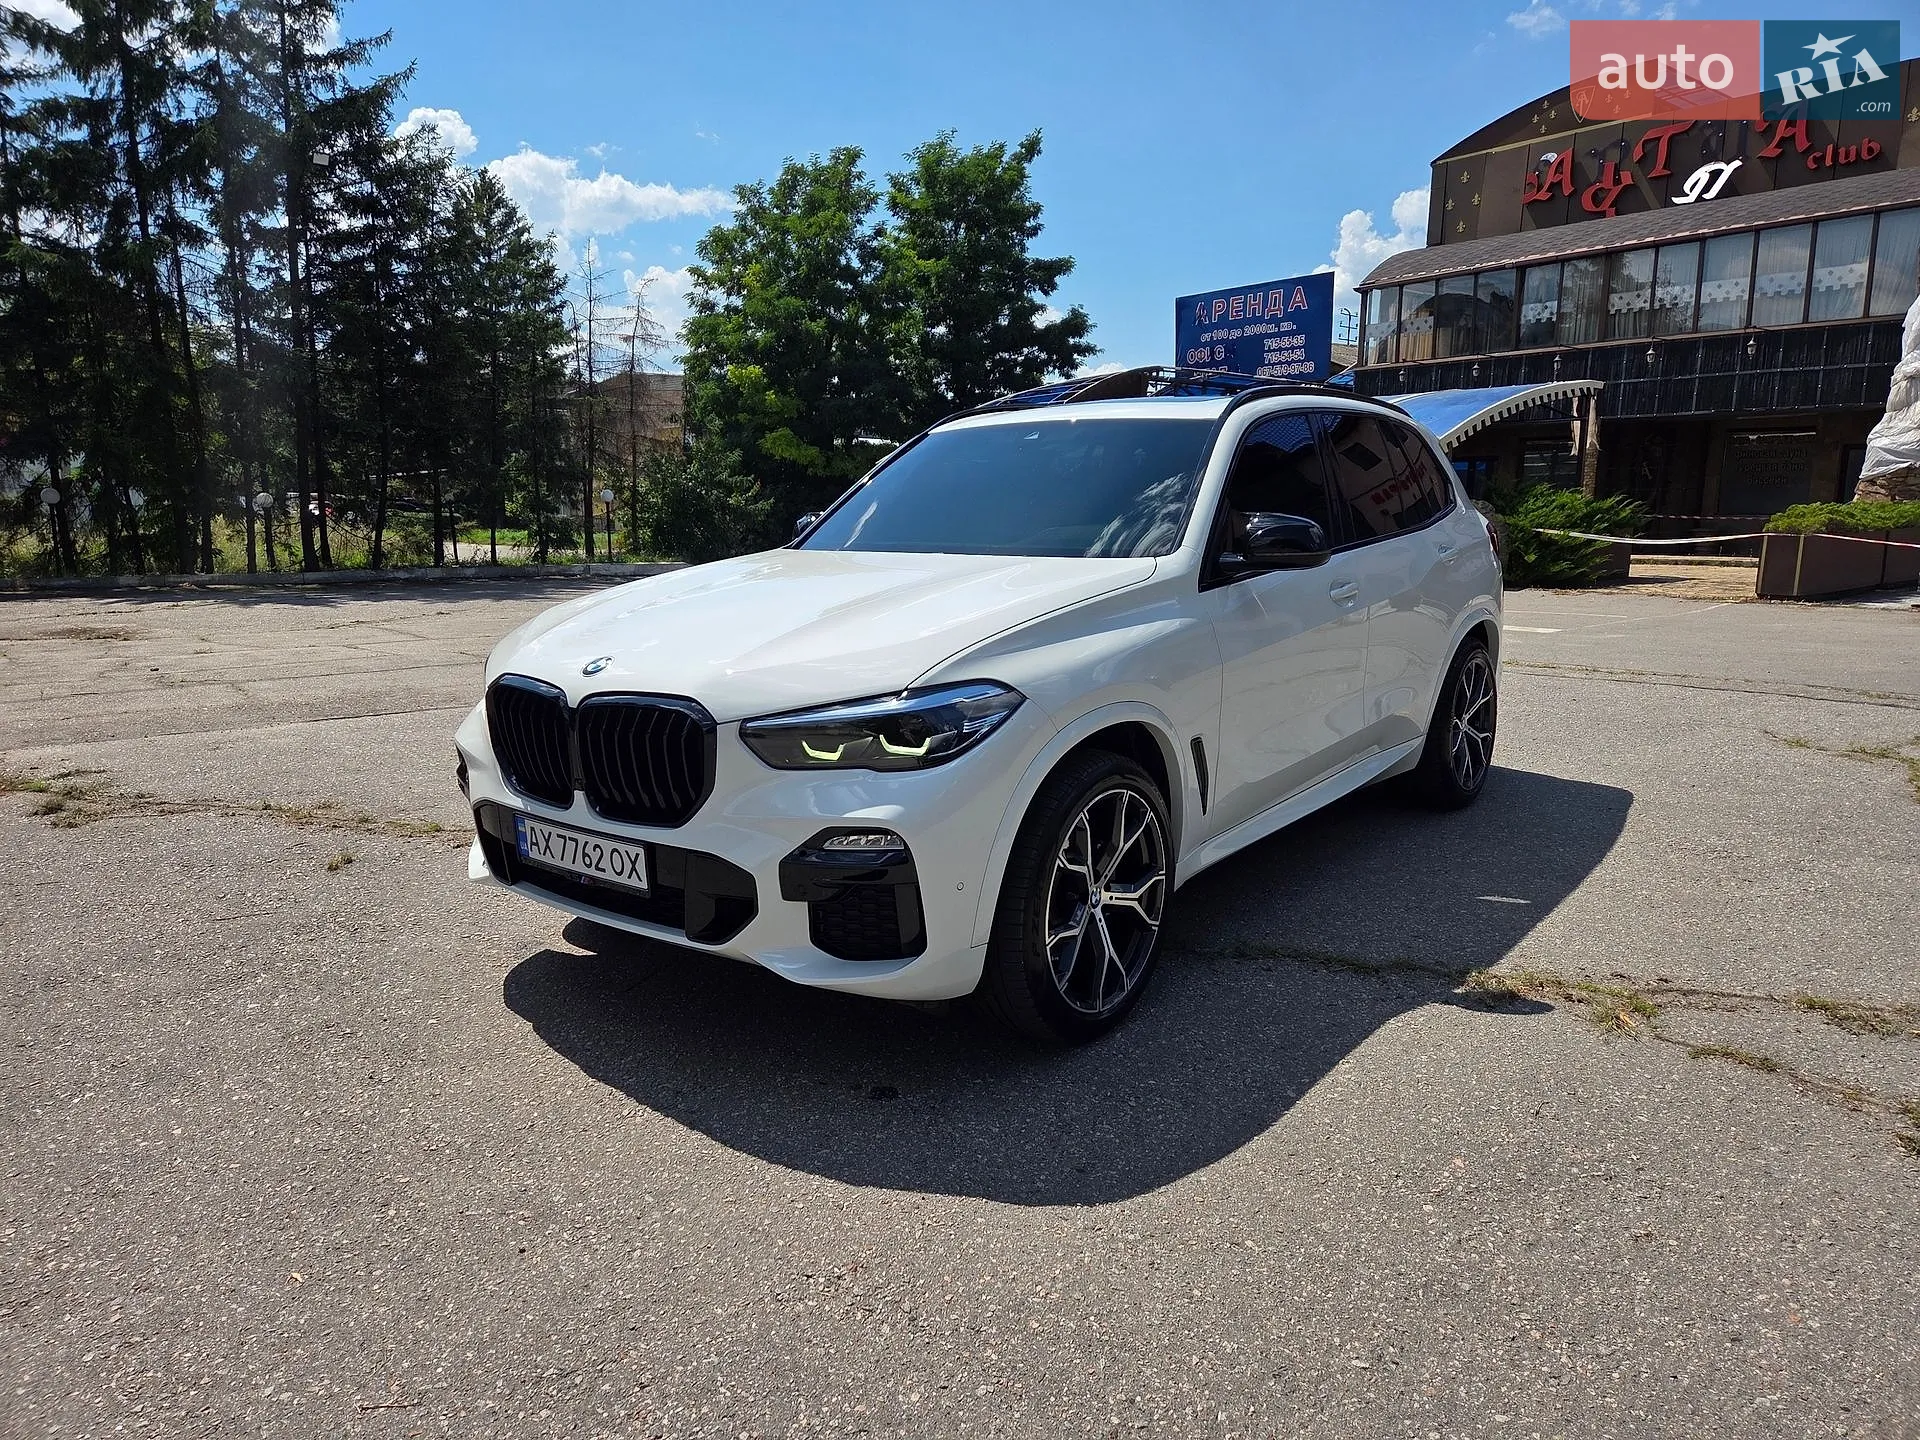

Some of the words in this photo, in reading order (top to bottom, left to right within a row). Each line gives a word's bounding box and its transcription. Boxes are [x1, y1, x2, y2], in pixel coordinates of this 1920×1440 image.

[1806, 136, 1882, 171] club
[1194, 286, 1308, 326] АРЕНДА
[556, 833, 606, 873] 7762
